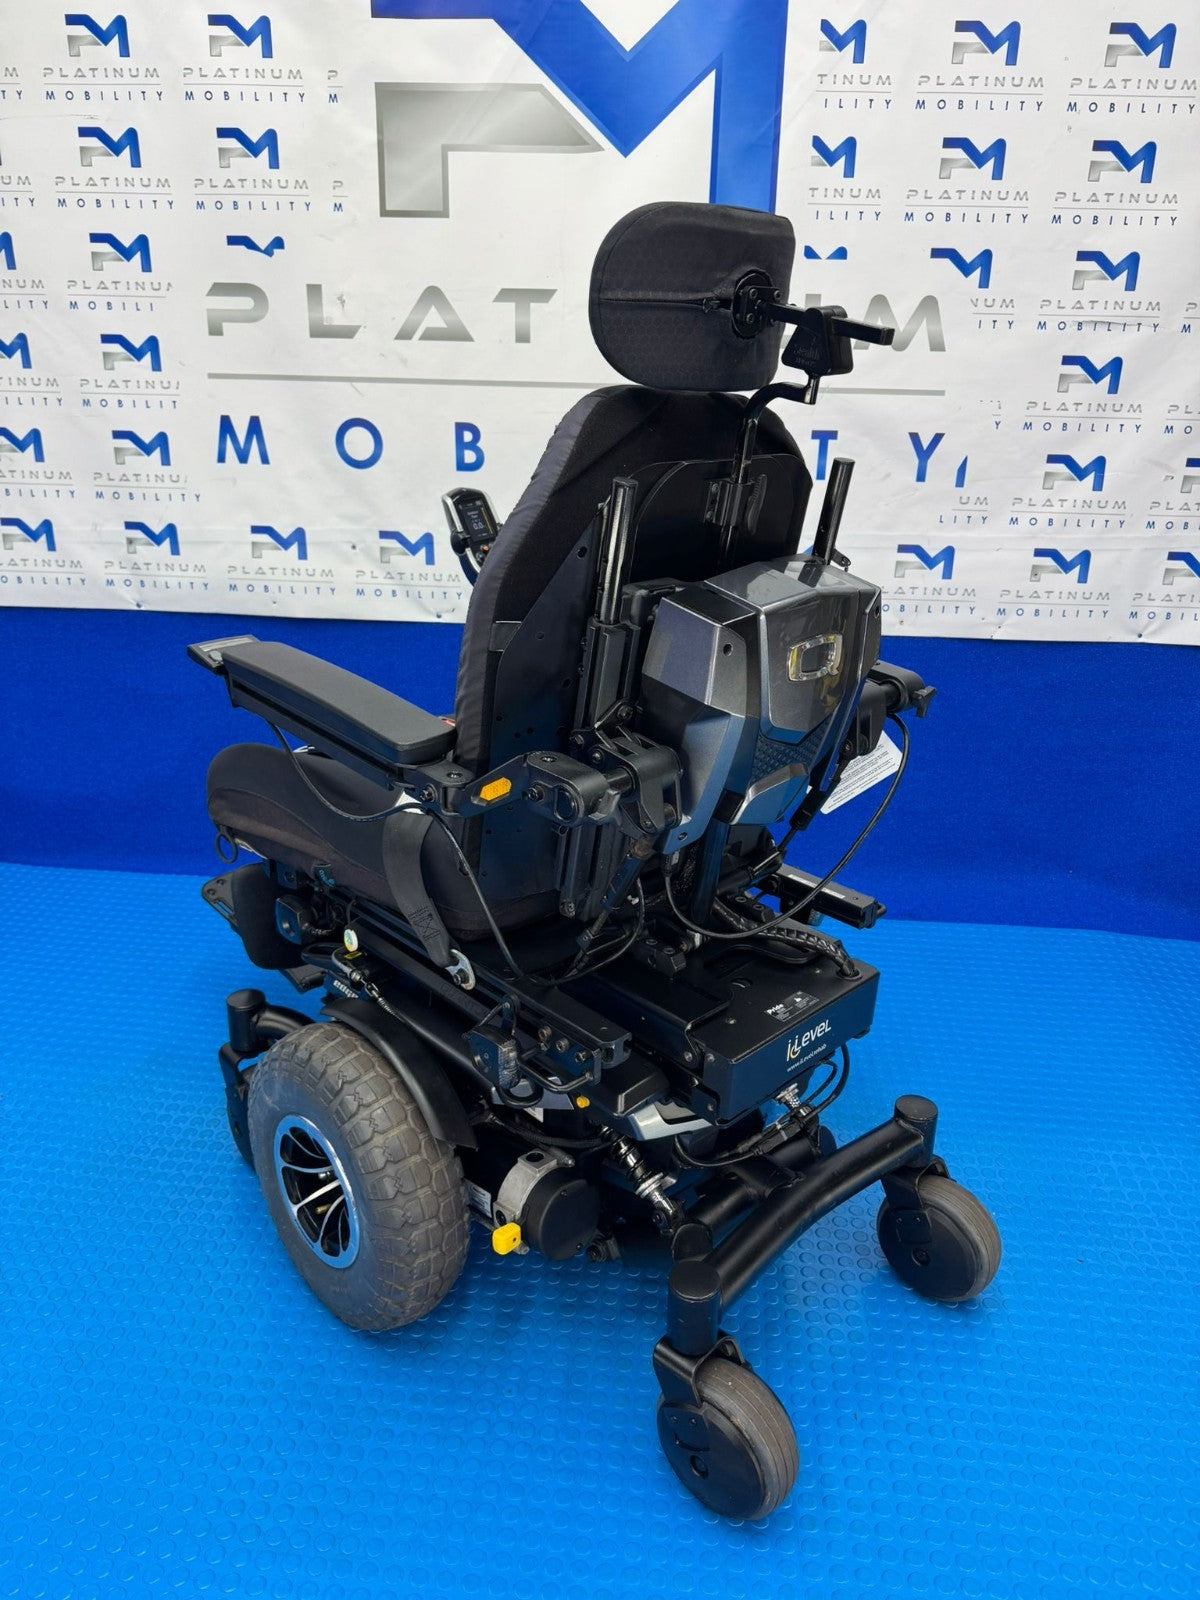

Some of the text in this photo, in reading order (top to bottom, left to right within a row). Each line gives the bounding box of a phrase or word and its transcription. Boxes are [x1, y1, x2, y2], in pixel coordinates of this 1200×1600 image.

[43, 67, 159, 78] PLATINUM
[183, 67, 303, 79] PLATINUM
[918, 75, 1044, 87] PLATINUM
[1071, 78, 1197, 90] PLATINUM
[46, 90, 162, 101] MOBILITY
[185, 91, 305, 102] MOBILITY
[915, 99, 1043, 111] MOBILITY
[1067, 102, 1195, 114] MOBILITY
[55, 176, 171, 188] PLATINUM
[194, 178, 308, 189] PLATINUM
[907, 189, 1028, 201] PLATINUM
[1055, 192, 1177, 204] PLATINUM
[58, 198, 173, 209] MOBILITY
[196, 200, 310, 211] MOBILITY
[904, 212, 1028, 223] MOBILITY
[1051, 214, 1177, 226] MOBILITY
[1040, 300, 1160, 311] PLATINUM
[1037, 320, 1160, 332] MOBILITY
[1027, 401, 1142, 413] PLATINUM
[1023, 422, 1141, 433] MOBILITY
[94, 472, 188, 483] PLATINU
[96, 491, 200, 502] MOBILITY
[1012, 498, 1126, 510] PLATINUM
[1009, 517, 1125, 528] MOBILITY
[105, 561, 206, 572] PLATINUM
[228, 566, 333, 577] PLATINUM
[356, 571, 460, 582] PLATINUM
[106, 579, 208, 590] MOBILITY
[229, 584, 335, 595] MOBILITY
[356, 588, 462, 599] MOBILITY
[1000, 590, 1110, 600] PLATINUM
[997, 608, 1108, 618] MOBILITY
